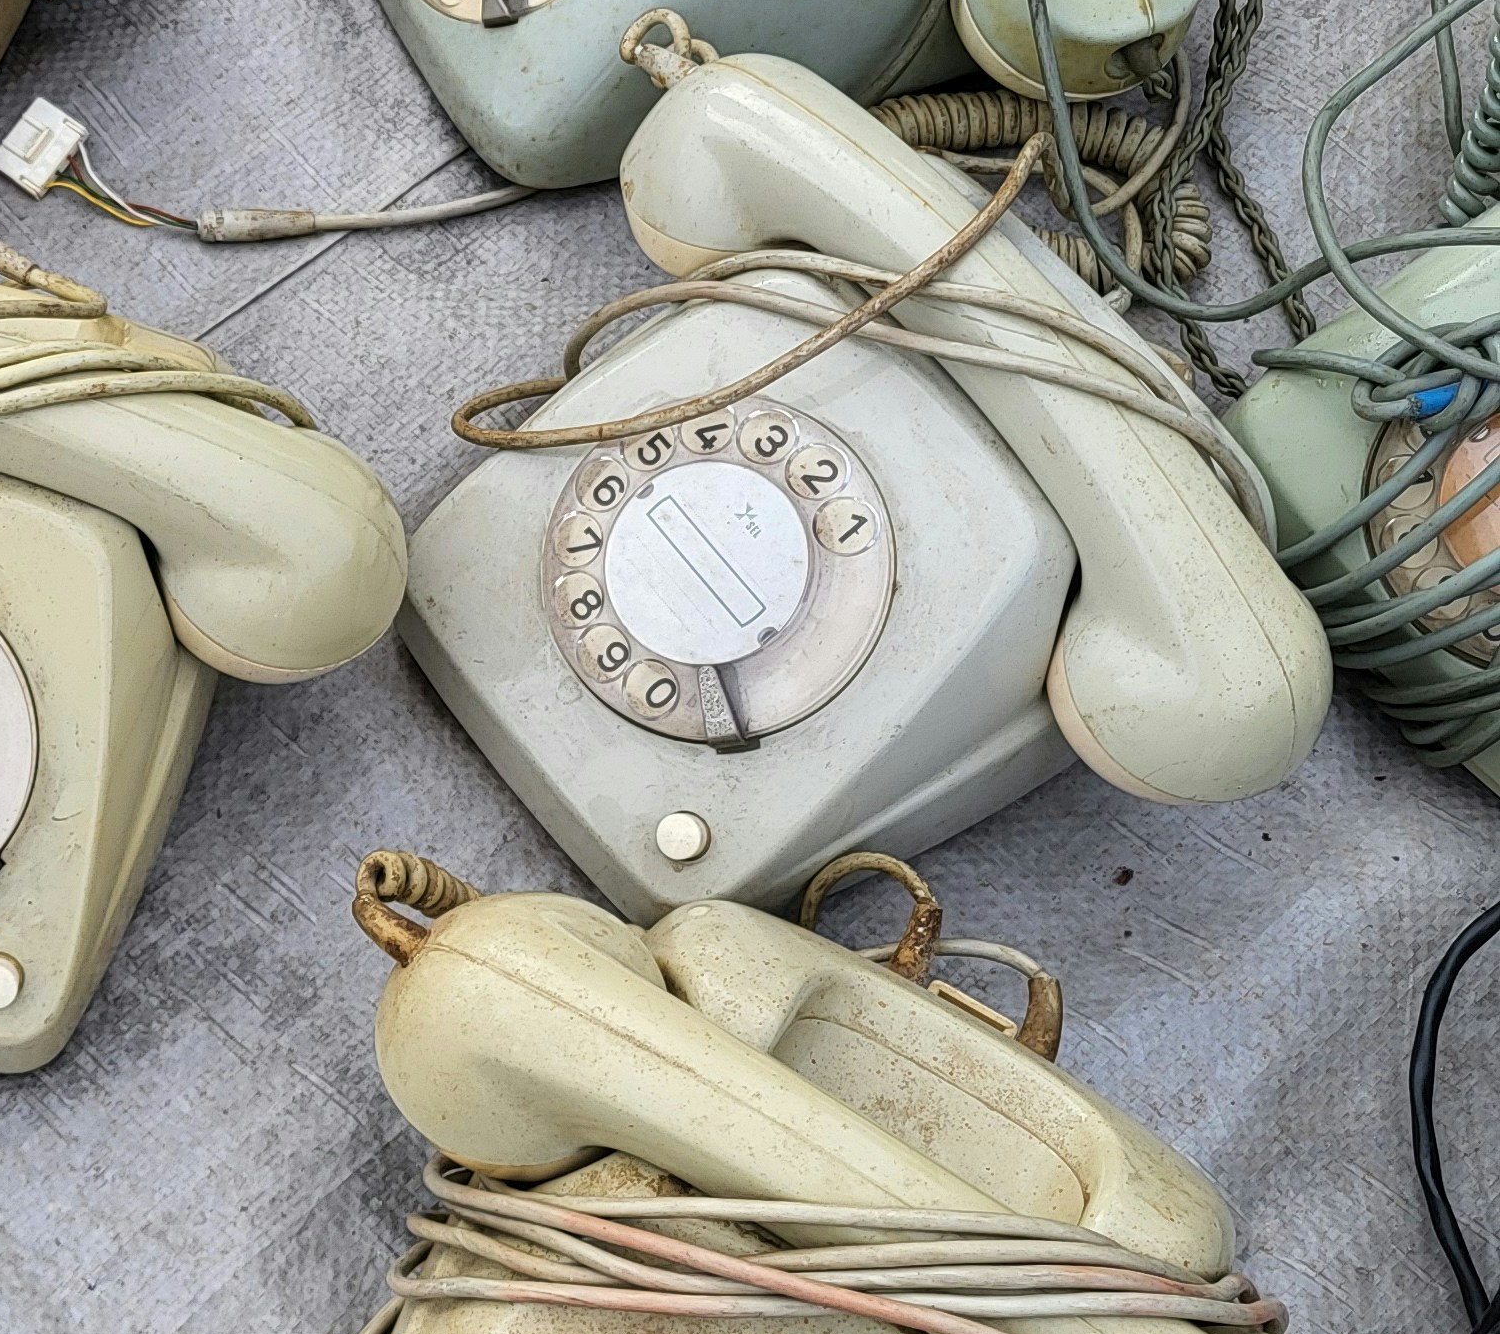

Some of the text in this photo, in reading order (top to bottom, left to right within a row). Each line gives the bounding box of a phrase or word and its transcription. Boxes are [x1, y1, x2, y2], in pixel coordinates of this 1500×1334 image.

[567, 423, 868, 709] 1 2 3 4 5 6 7 8 9 0
[745, 519, 762, 539] SEL
